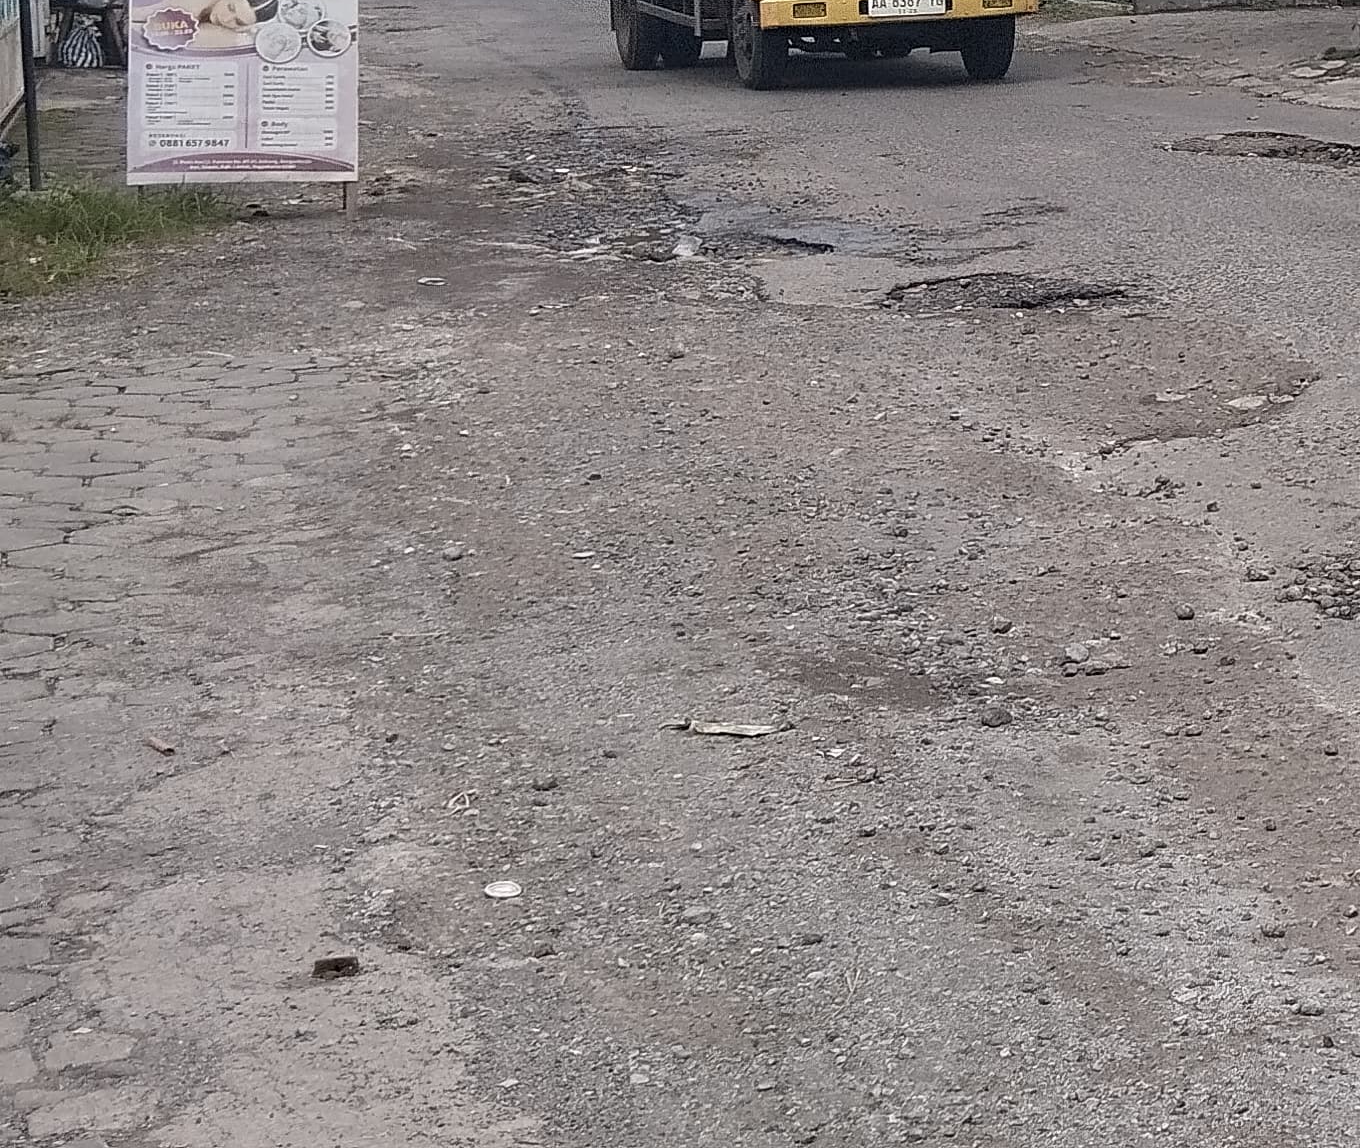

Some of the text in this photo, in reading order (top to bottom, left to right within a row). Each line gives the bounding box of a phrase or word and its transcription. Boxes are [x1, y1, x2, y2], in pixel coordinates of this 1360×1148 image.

[159, 139, 230, 147] 0881 657 9847
